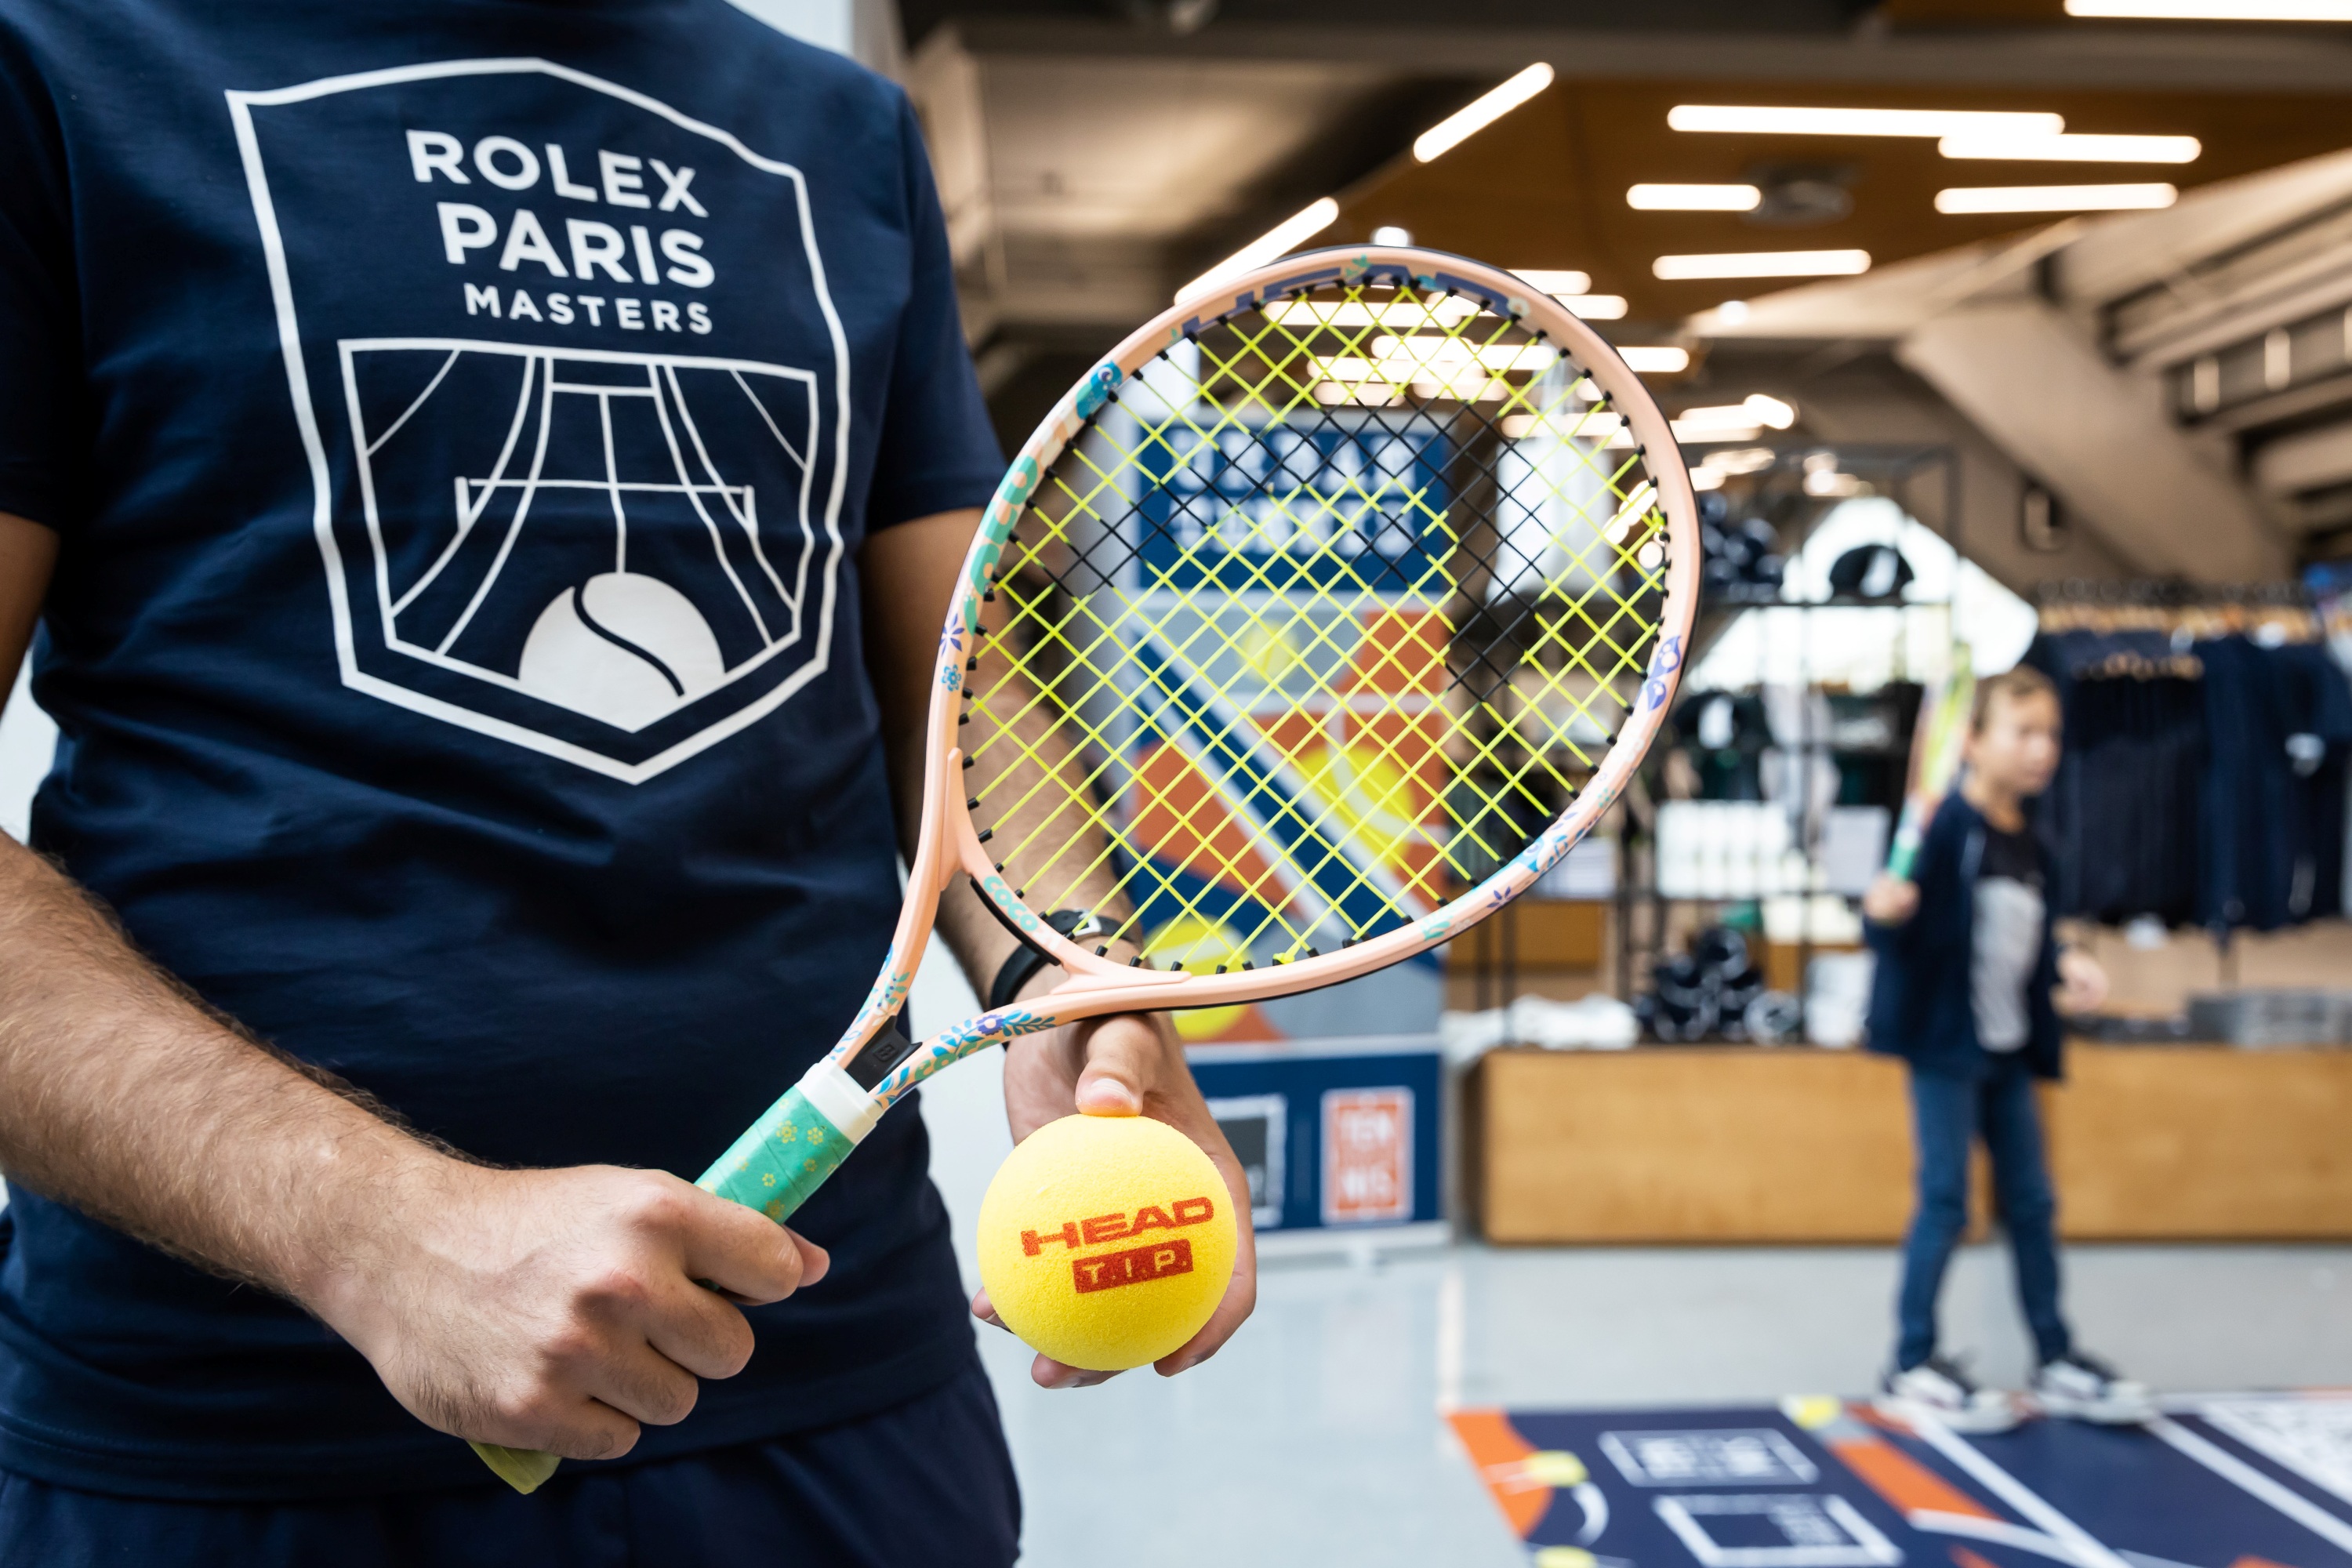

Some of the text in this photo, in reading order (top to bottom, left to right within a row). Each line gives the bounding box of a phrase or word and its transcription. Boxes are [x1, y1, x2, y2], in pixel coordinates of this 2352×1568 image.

[406, 129, 709, 217] ROLEX
[437, 201, 715, 289] PARIS
[464, 282, 713, 335] MASTERS
[983, 876, 1038, 932] COCO
[1021, 1196, 1214, 1257] HEAD
